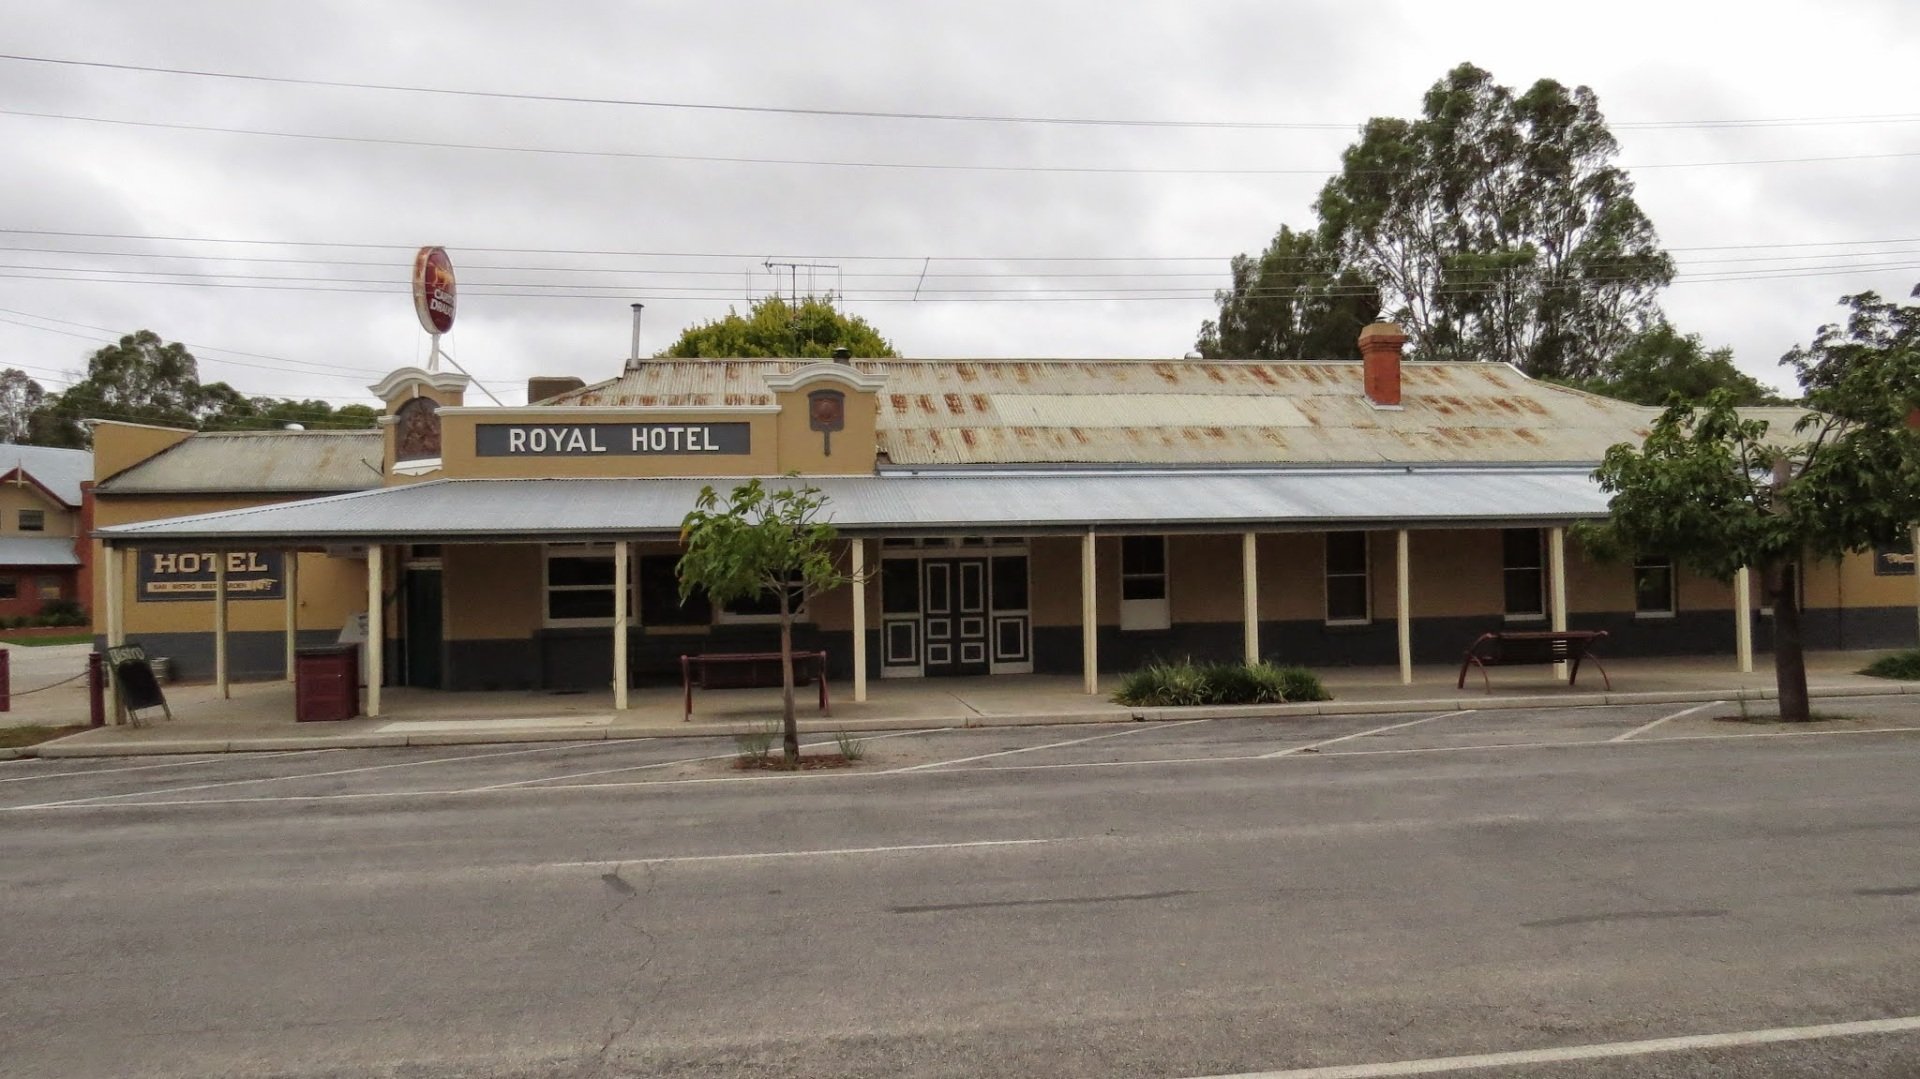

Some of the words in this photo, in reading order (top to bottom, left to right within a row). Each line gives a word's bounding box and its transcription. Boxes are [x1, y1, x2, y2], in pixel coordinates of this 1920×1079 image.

[509, 428, 607, 452] ROYAL
[632, 427, 720, 451] HOTEL
[153, 552, 268, 574] HOTEL
